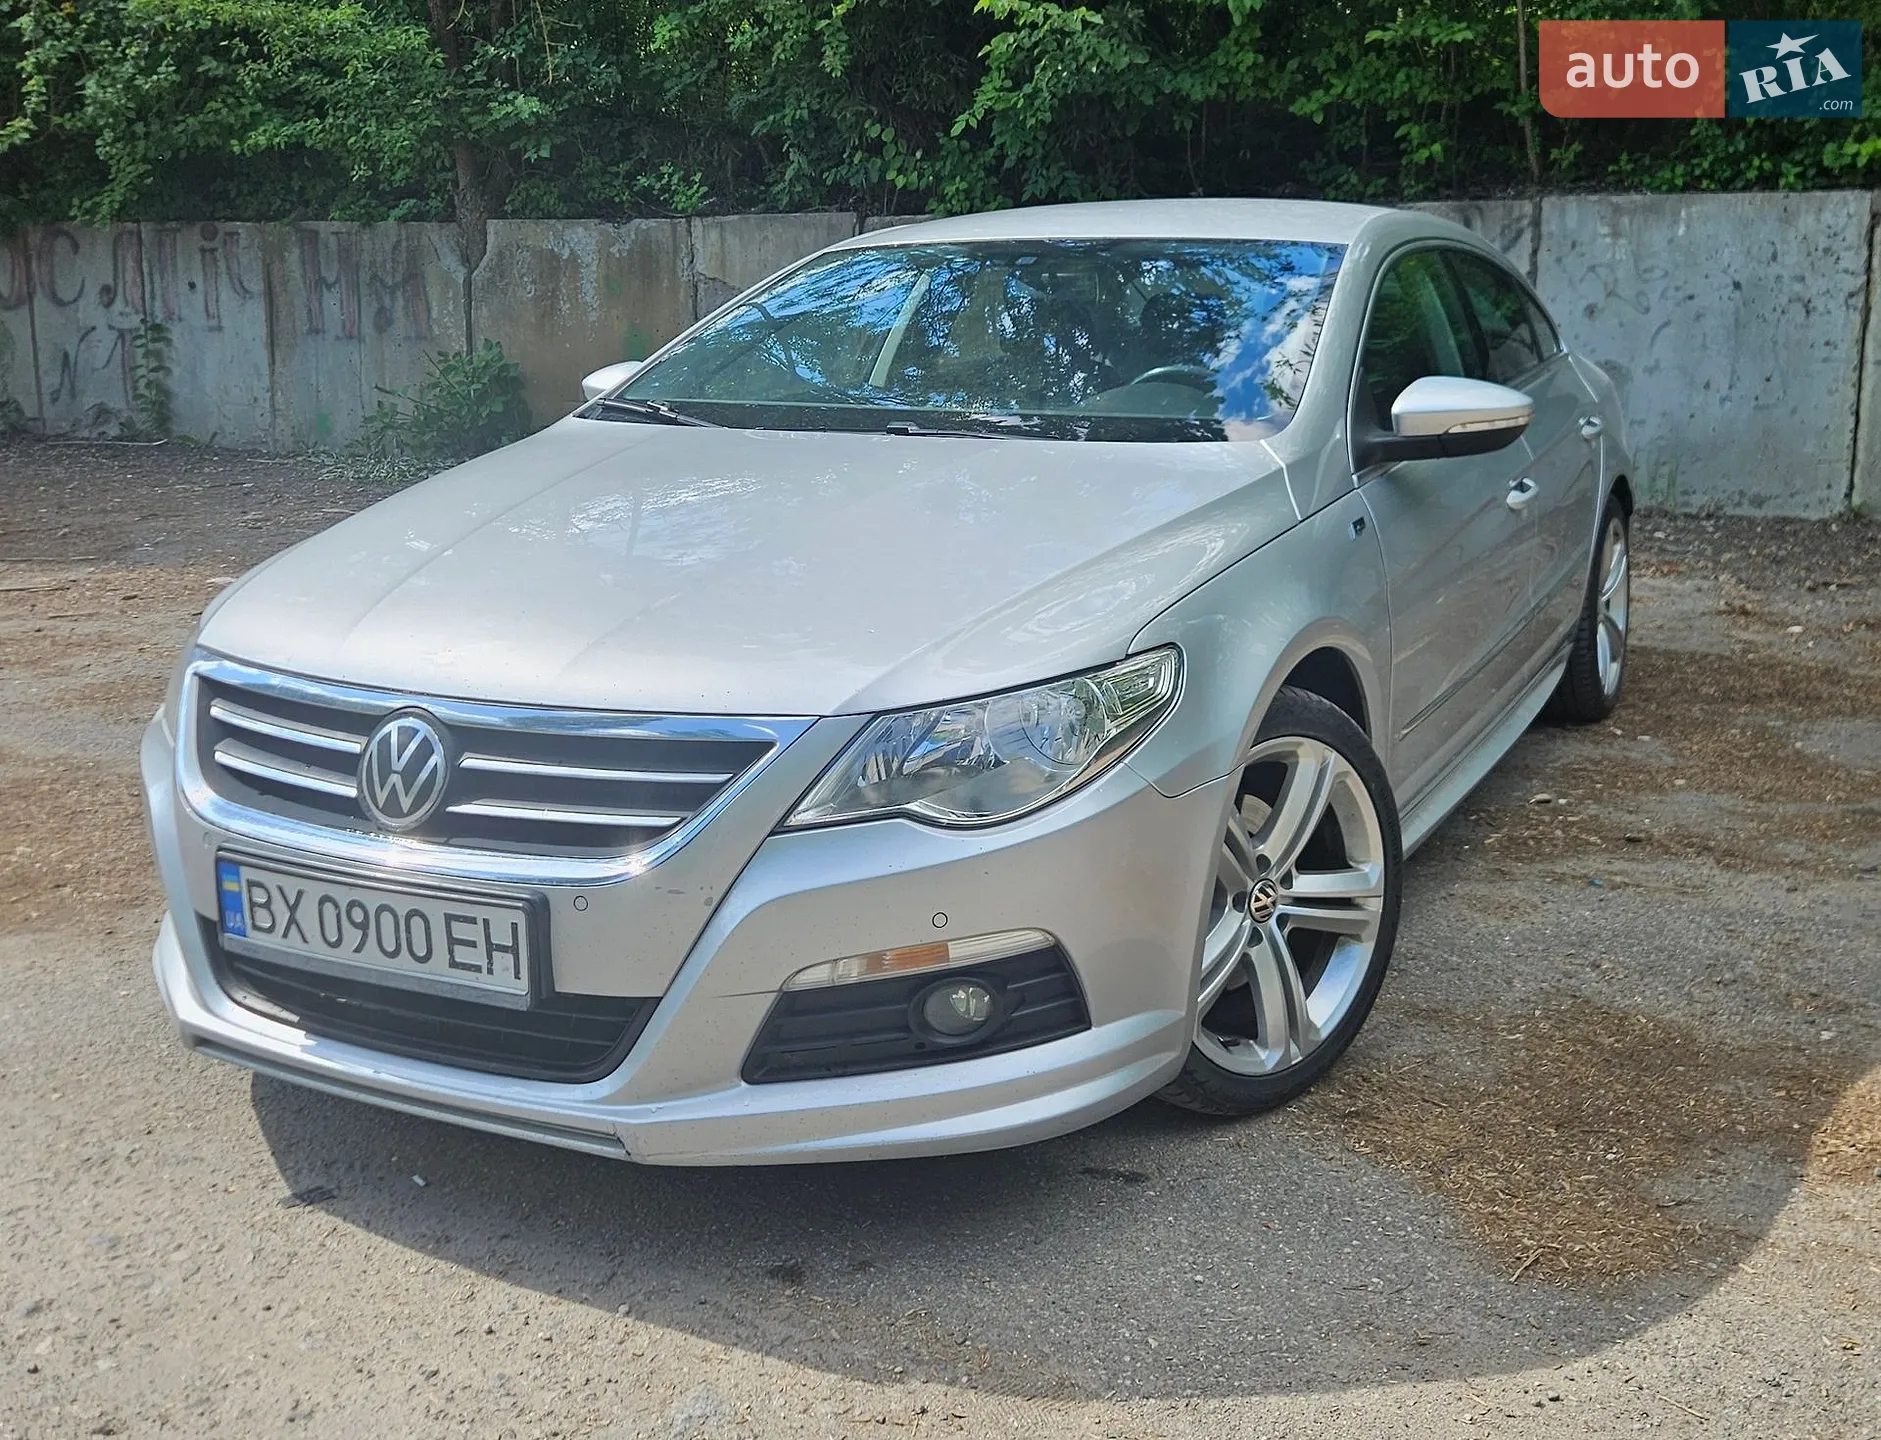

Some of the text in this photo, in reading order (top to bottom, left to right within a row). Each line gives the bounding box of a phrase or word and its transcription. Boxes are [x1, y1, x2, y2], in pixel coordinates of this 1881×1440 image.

[246, 877, 522, 981] BX 0900 EH
